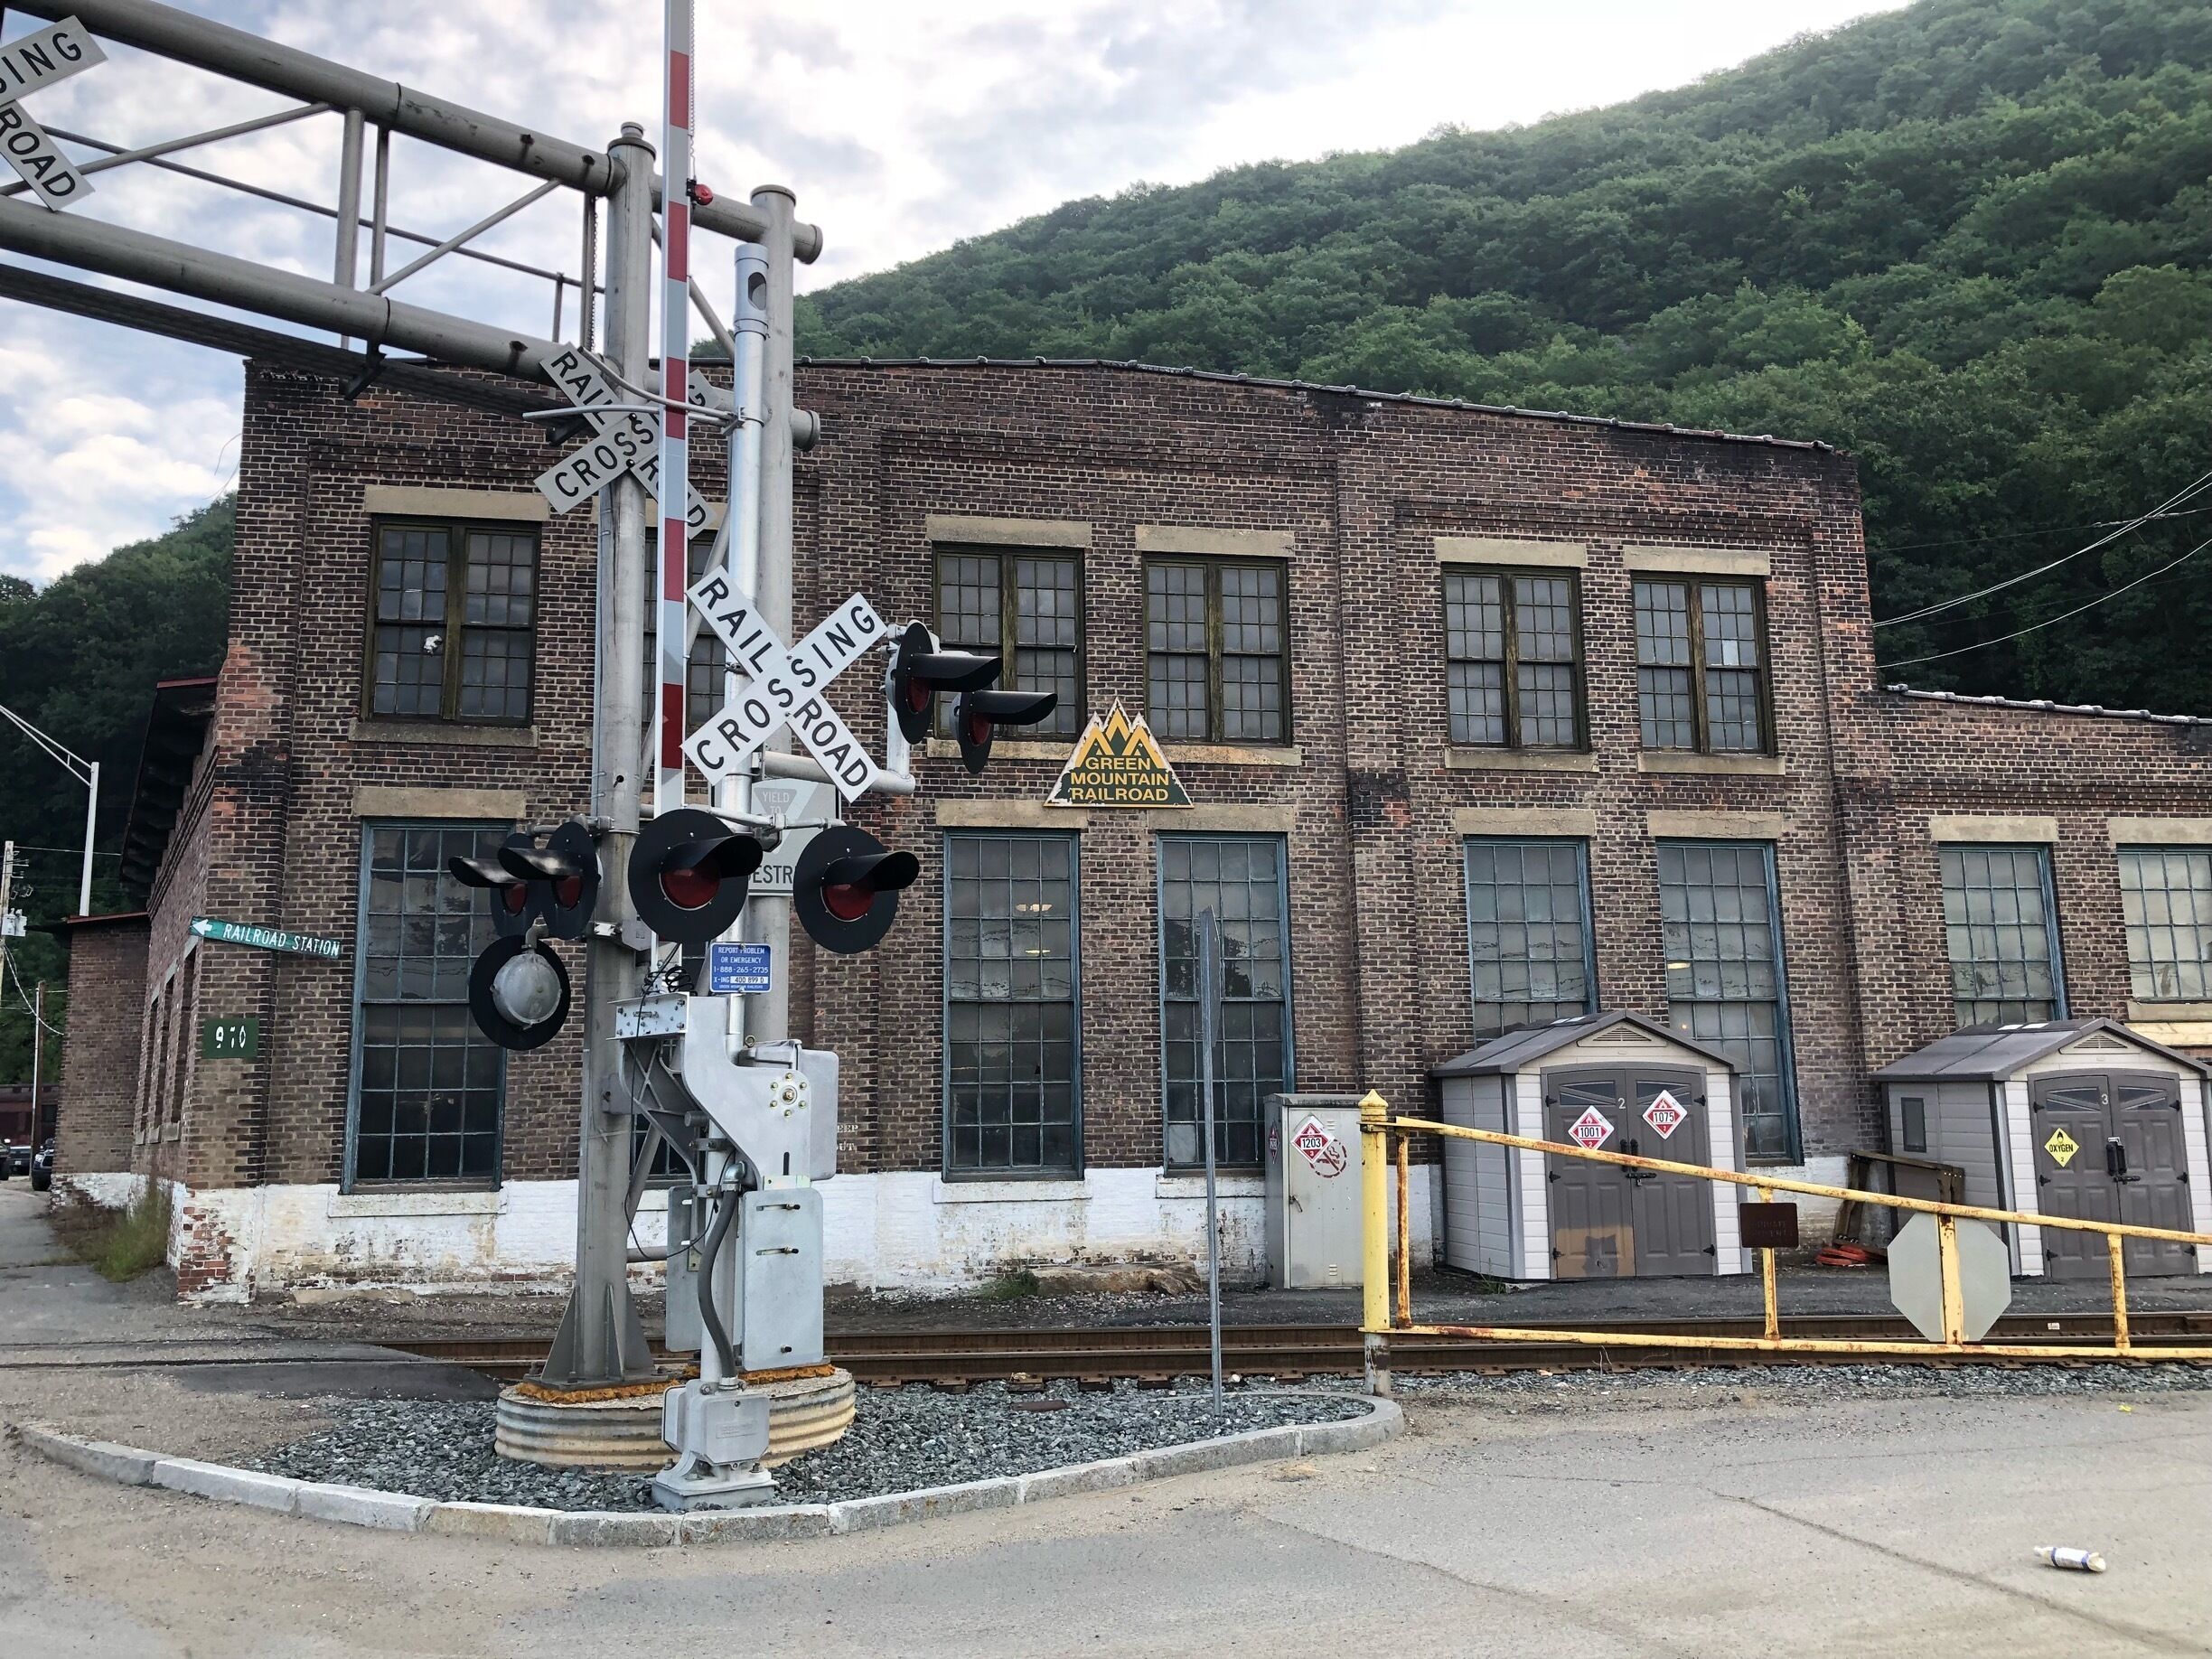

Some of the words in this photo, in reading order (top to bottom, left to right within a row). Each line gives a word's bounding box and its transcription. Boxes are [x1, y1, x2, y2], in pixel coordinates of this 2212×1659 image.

[0, 33, 82, 93] ING
[0, 108, 76, 197] ROAD
[550, 351, 614, 426] RAIL
[554, 384, 706, 497] CROSSG
[639, 455, 706, 527] RD
[698, 576, 773, 674] RAIL
[697, 605, 876, 770] CROSSING
[793, 697, 868, 787] ROAD
[1085, 757, 1150, 770] GREEN
[1070, 773, 1169, 786] MOUNTAIN
[762, 791, 790, 803] YIELD
[1072, 788, 1169, 801] RAILROAD
[223, 923, 287, 948] RAILROAD
[292, 935, 341, 957] STATION
[718, 946, 738, 954] REPORT
[1617, 1097, 1626, 1110] 2
[2101, 1093, 2109, 1105] 3
[1654, 1111, 1674, 1122] 1075
[837, 1124, 858, 1133] EEP
[1580, 1127, 1599, 1138] 1001
[1302, 1138, 1321, 1148] 1203
[2048, 1144, 2074, 1153] OXYGEN
